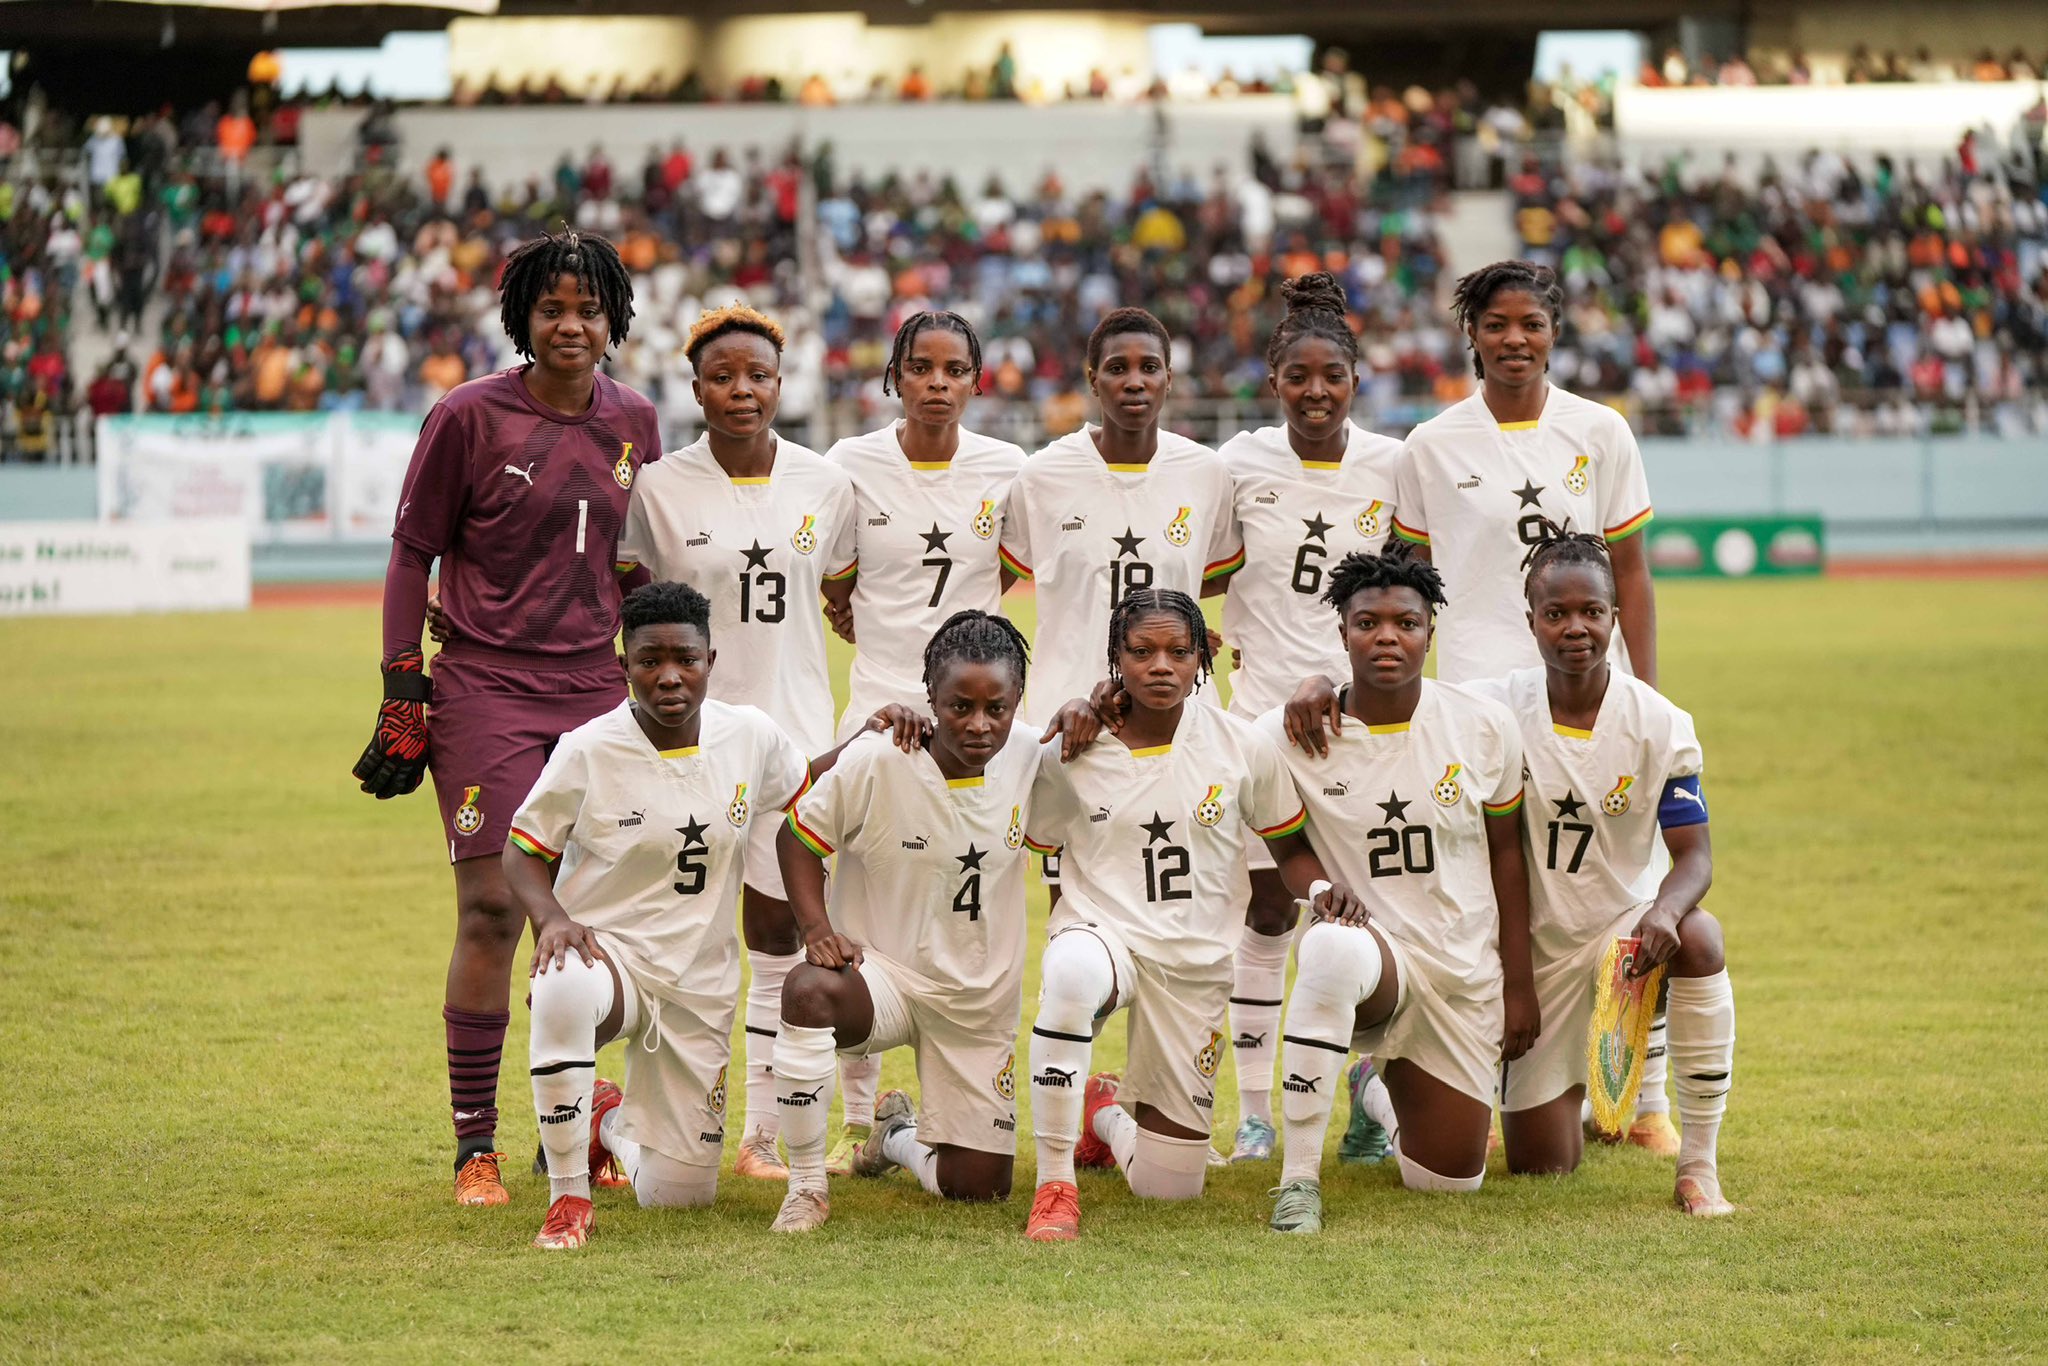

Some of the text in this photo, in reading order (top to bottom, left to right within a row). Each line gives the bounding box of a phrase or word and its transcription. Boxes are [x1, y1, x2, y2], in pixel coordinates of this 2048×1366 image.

[1457, 480, 1479, 489] PUMA
[1255, 496, 1276, 504] PUMA
[576, 500, 588, 553] 1
[868, 518, 888, 526] PUMA
[1062, 522, 1082, 531] PUMA
[686, 537, 709, 547] PUMA
[1291, 543, 1327, 595] 6
[922, 558, 952, 608] 7
[1109, 560, 1153, 609] 18
[739, 572, 786, 624] 13
[1323, 787, 1345, 796] PUMA
[618, 817, 642, 828] PUMA
[902, 840, 925, 850] PUMA
[1367, 825, 1434, 878] 20
[1547, 821, 1594, 873] 17
[674, 846, 708, 895] 5
[1142, 845, 1192, 902] 12
[953, 873, 981, 921] 4
[1033, 1075, 1066, 1088] PUMA
[777, 1096, 811, 1107] PUMA
[540, 1111, 576, 1124] PUMA
